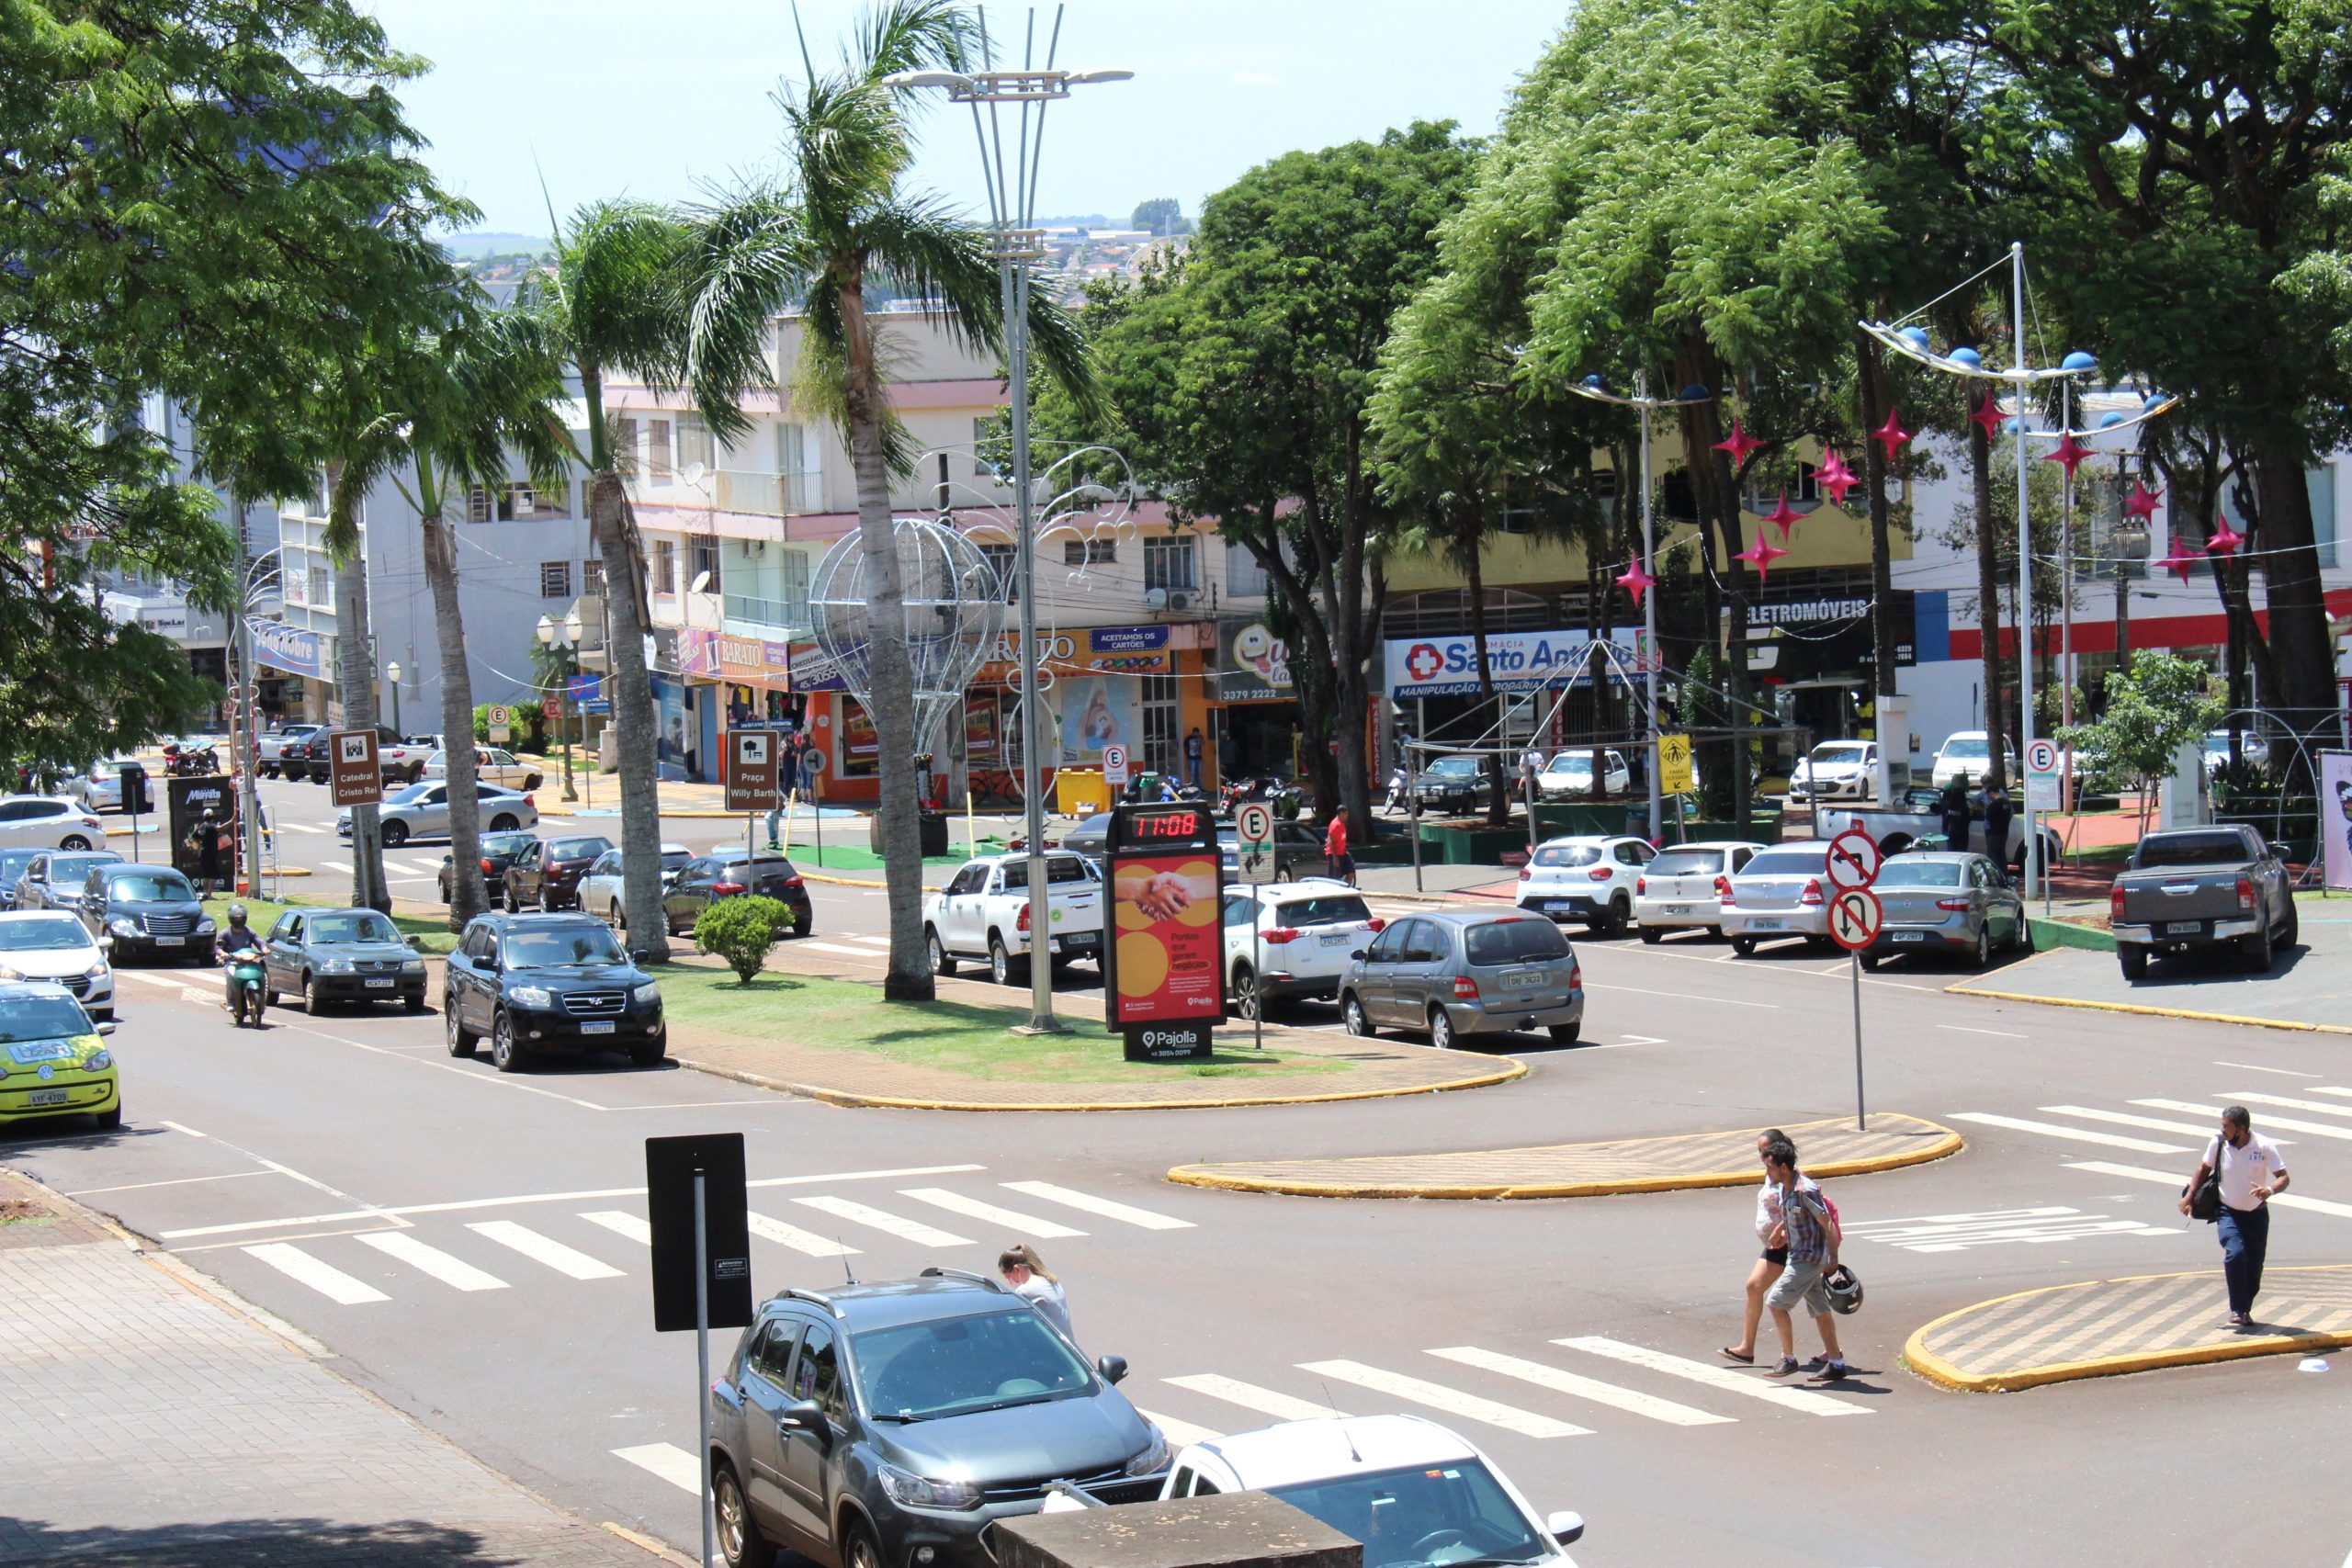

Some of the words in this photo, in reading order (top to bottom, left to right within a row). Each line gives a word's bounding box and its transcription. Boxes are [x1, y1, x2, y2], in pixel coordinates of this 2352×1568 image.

[1101, 634, 1141, 642] ACEITAMOS
[1112, 640, 1145, 649] CARTÕES
[705, 639, 721, 672] KI
[722, 640, 761, 668] BARATO
[1224, 691, 1249, 700] 3379
[1251, 690, 1276, 699] 2222
[1399, 682, 1476, 697] MANIPULAÇÃO
[1491, 681, 1540, 692] ROGARIA
[1111, 751, 1119, 764] E
[2037, 749, 2047, 765] E
[340, 772, 374, 783] Catedral
[741, 773, 765, 784] Praça
[338, 787, 363, 797] Cristo
[364, 785, 379, 795] Rei
[730, 789, 751, 799] Willy
[753, 788, 776, 797] Barth
[1137, 813, 1197, 838] 11:08
[1250, 813, 1261, 834] E
[1171, 932, 1199, 941] Pontos
[1157, 1030, 1197, 1047] Pajolla
